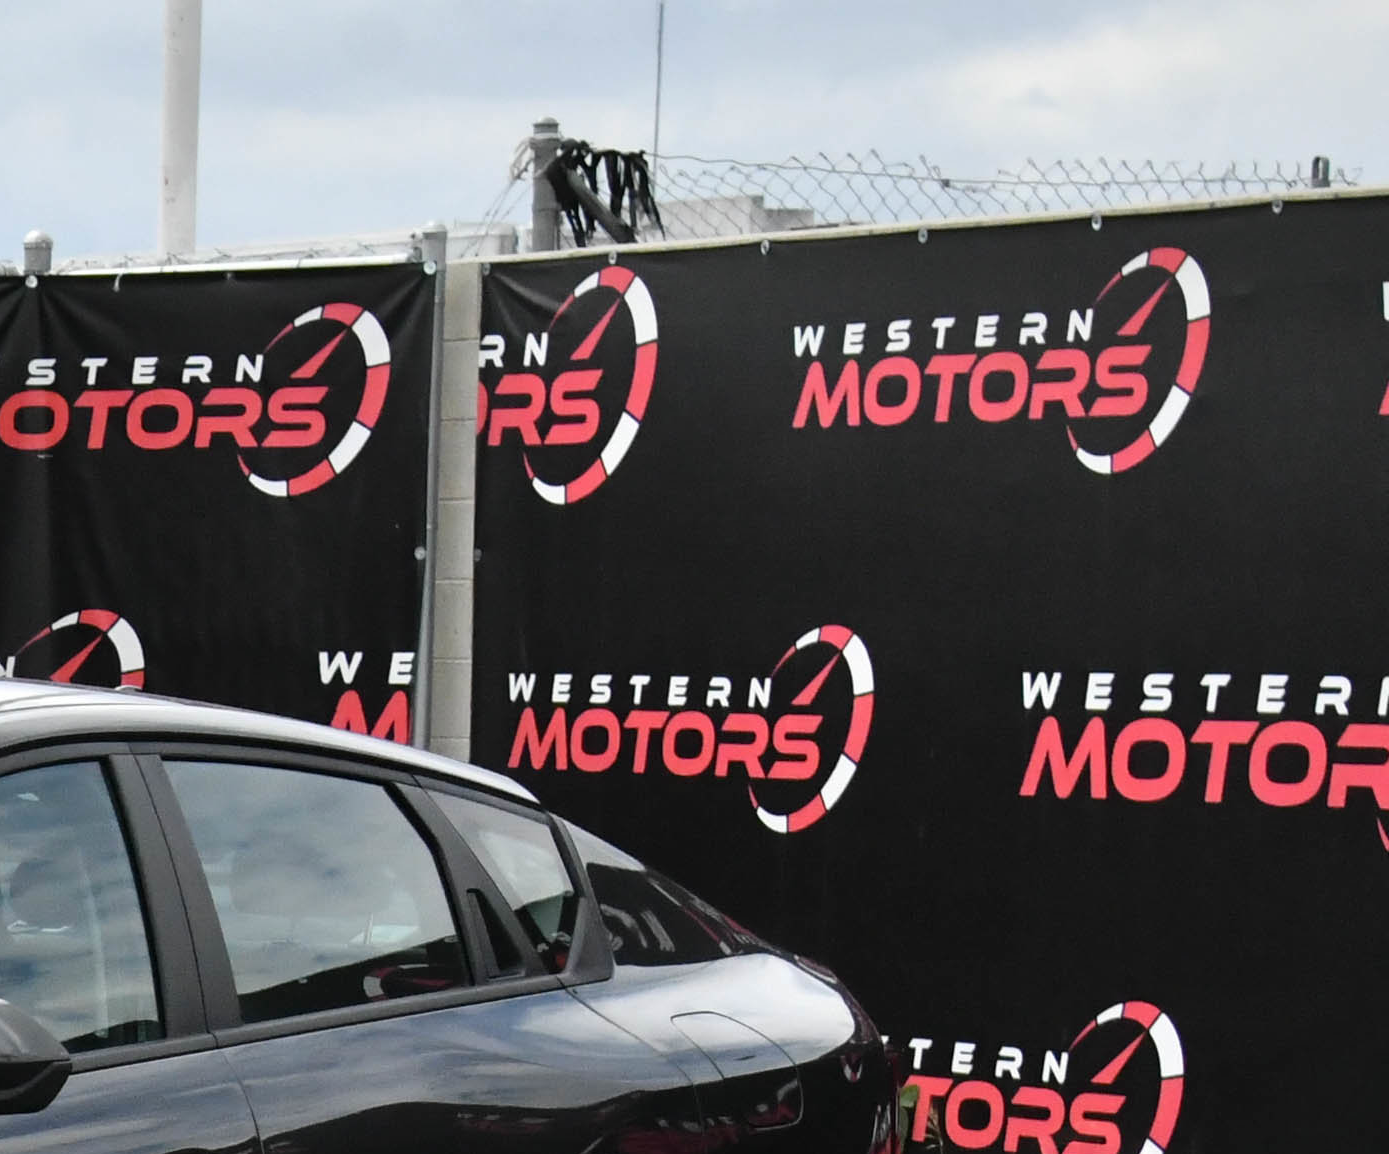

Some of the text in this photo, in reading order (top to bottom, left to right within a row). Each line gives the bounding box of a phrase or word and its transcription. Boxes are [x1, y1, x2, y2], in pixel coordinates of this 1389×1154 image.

[794, 308, 1093, 357] WESTERN
[477, 369, 603, 446] RS
[794, 345, 1151, 428] MOTORS
[319, 651, 415, 684] WE
[509, 673, 771, 708] WESTERN
[509, 708, 823, 780] MOTORS
[880, 1036, 1068, 1084] TERN
